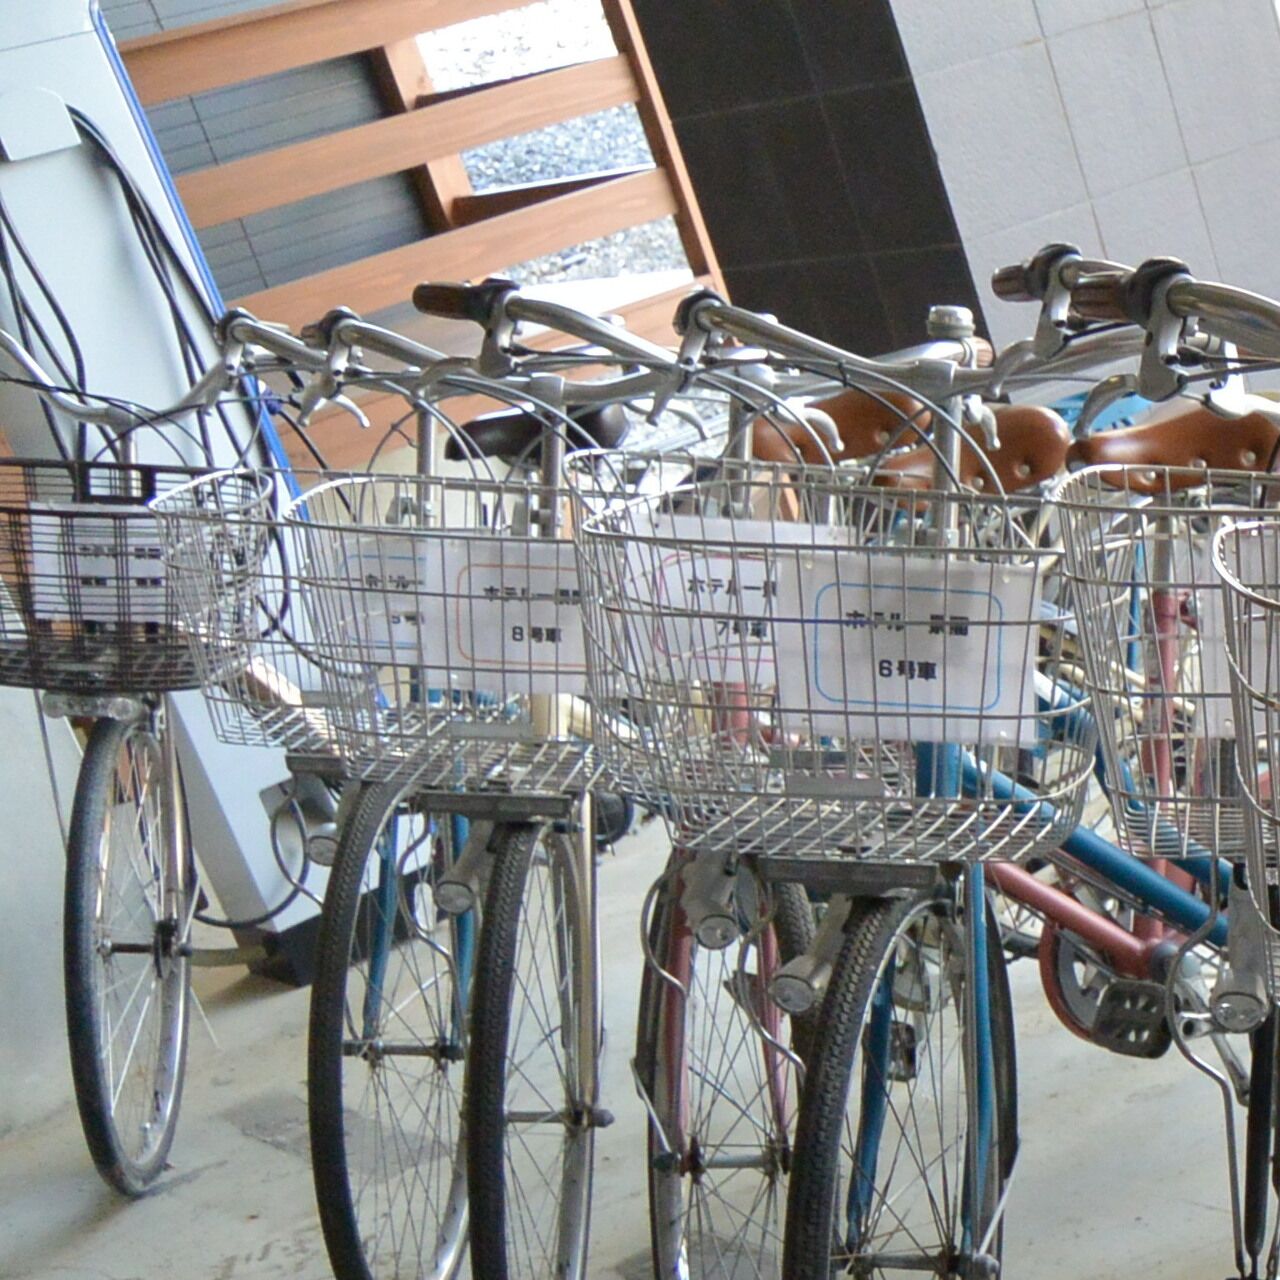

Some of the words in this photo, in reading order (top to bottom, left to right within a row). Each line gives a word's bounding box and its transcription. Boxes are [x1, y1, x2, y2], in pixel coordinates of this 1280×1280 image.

[845, 610, 970, 636] ホテル景閣
[877, 659, 938, 681] 6号車
